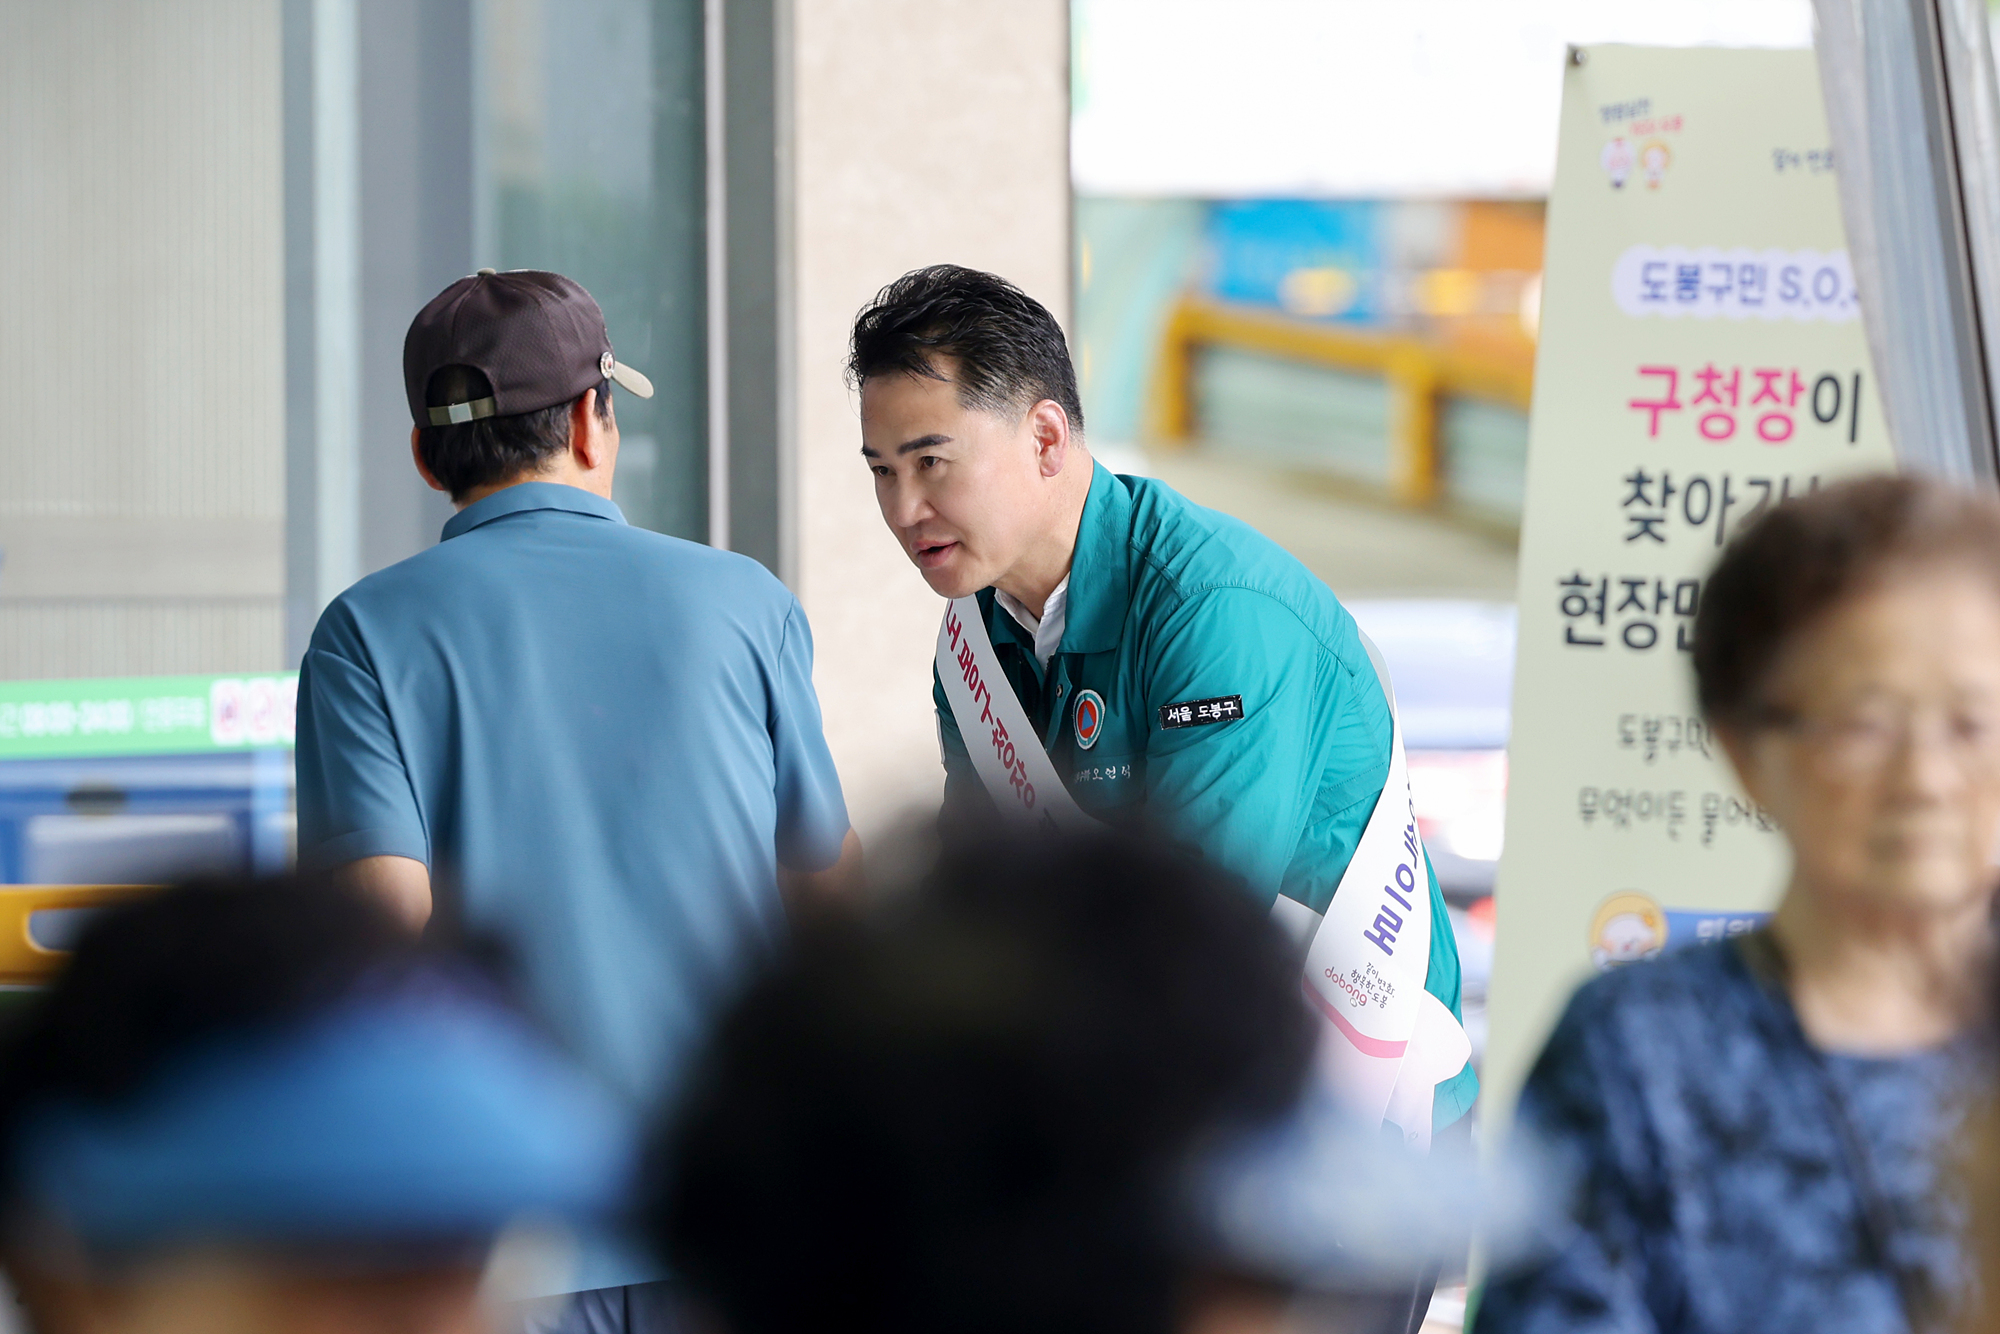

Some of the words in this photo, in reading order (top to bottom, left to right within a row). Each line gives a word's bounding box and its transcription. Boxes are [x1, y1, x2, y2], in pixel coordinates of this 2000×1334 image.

[1640, 262, 1767, 305] 도봉구민
[1779, 265, 1859, 307] S.O.
[1629, 365, 1859, 443] 구청장이
[1167, 706, 1193, 723] 서울
[1197, 701, 1238, 720] 도봉구
[1324, 966, 1368, 1007] dobong
[1350, 969, 1376, 995] 행복한
[1371, 992, 1388, 1009] 도봉
[1366, 962, 1379, 979] 같이
